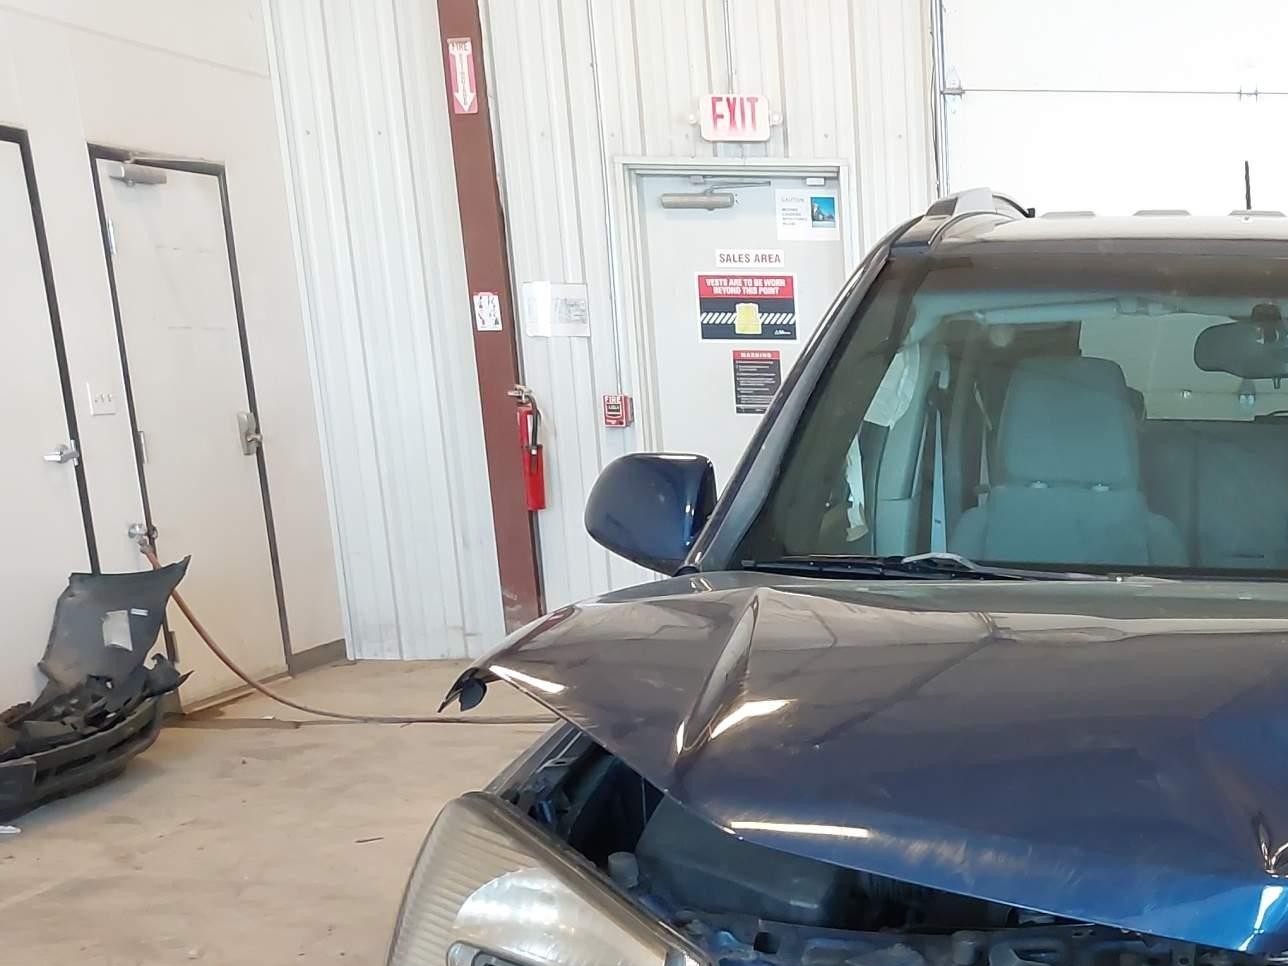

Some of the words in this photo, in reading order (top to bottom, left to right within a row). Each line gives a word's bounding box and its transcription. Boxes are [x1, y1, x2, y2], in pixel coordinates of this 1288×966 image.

[711, 96, 759, 130] EXIT
[719, 253, 751, 264] SALES
[753, 253, 781, 264] AREA
[705, 278, 728, 287] VESTS
[728, 278, 743, 287] ARE
[743, 278, 752, 287] TO
[753, 278, 763, 287] BE
[763, 278, 786, 287] WORN
[712, 286, 741, 295] BEYOND
[742, 286, 758, 295] THIS
[758, 286, 780, 295] POINT
[740, 351, 772, 359] WARNING
